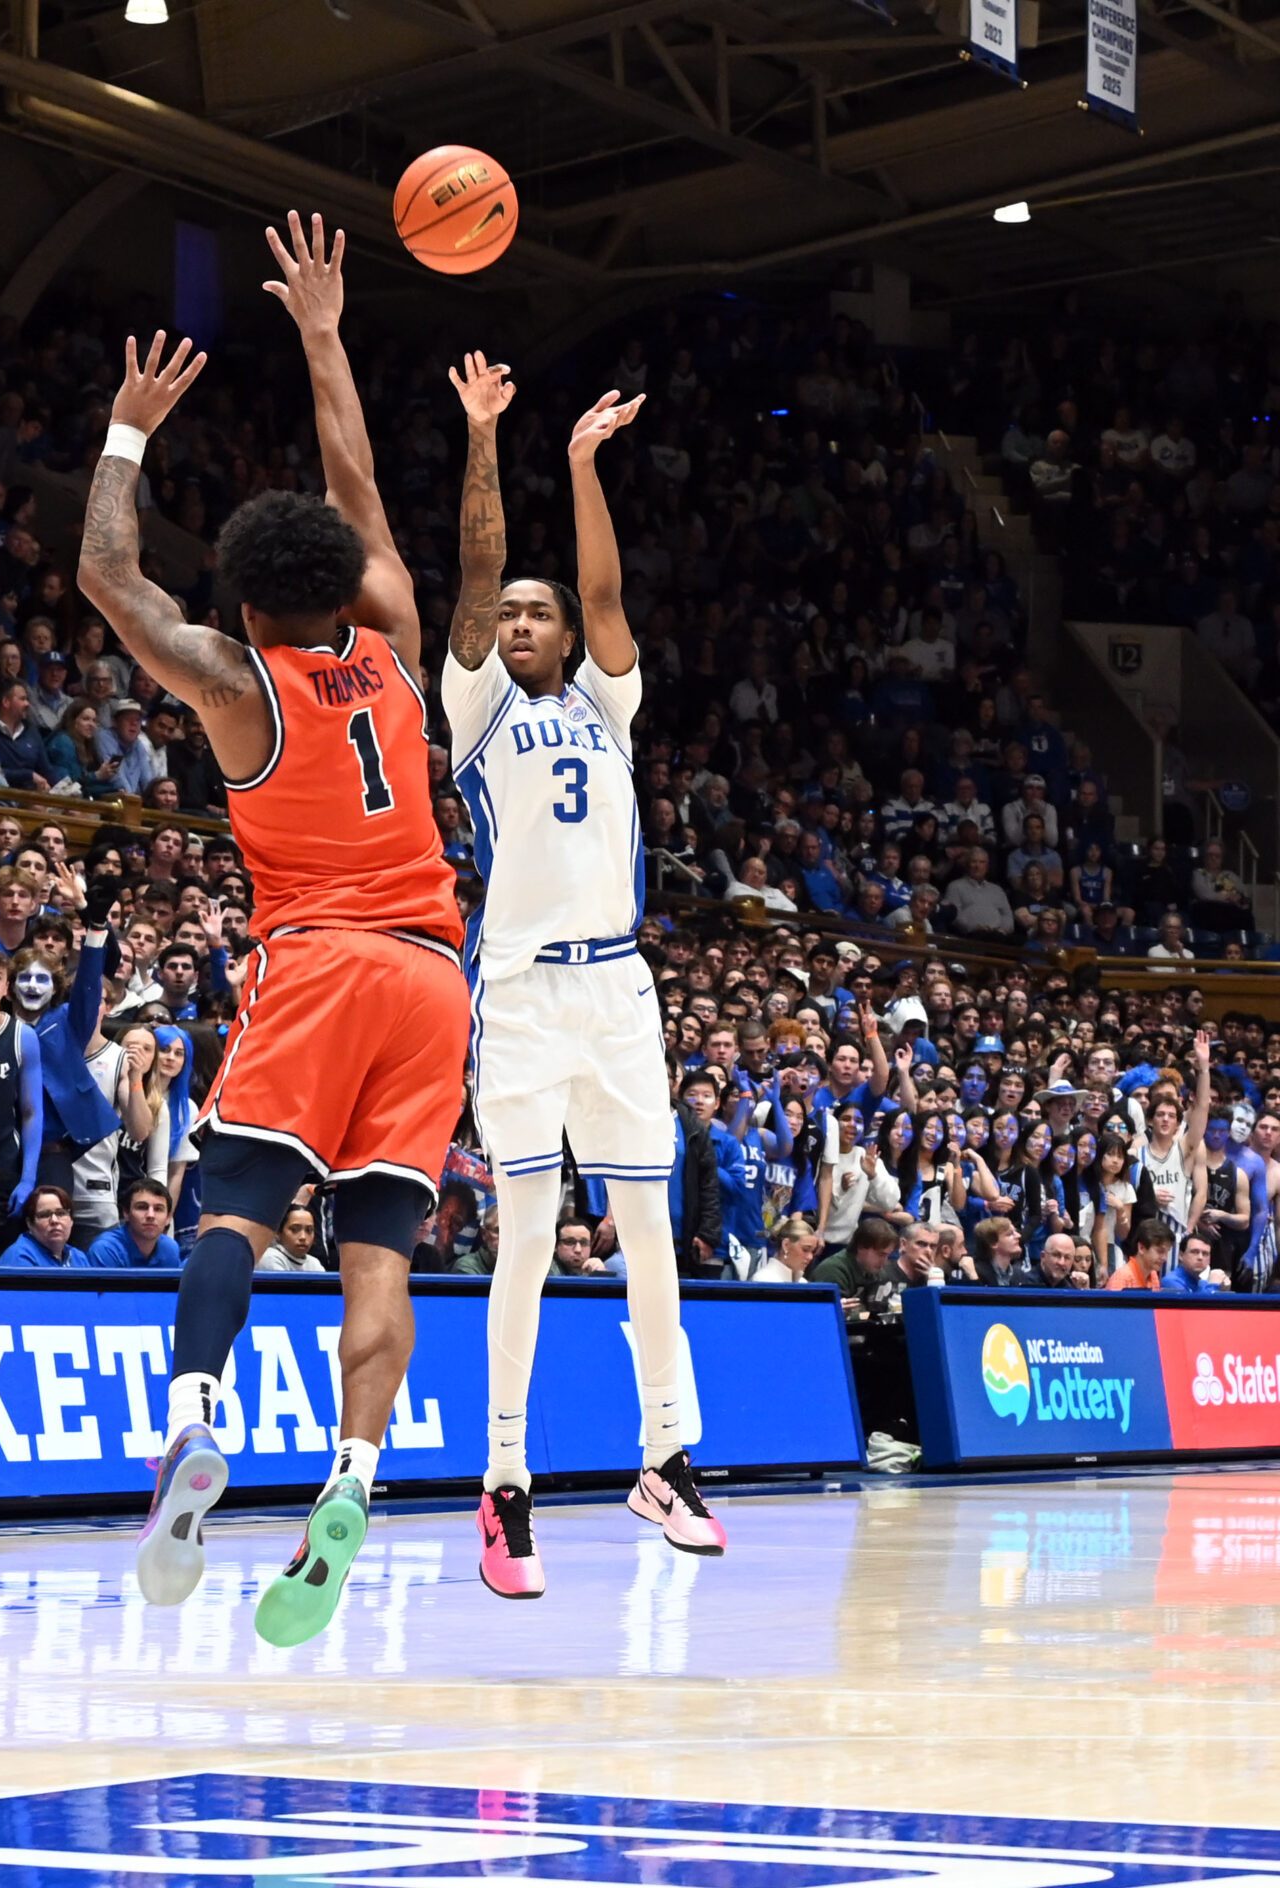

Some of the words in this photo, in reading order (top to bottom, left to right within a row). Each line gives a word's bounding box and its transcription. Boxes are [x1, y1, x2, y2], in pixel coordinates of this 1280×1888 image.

[1115, 645, 1138, 668] 12
[347, 706, 395, 816] 1
[510, 718, 608, 756] DUKE
[552, 757, 589, 823] 3
[1026, 1338, 1047, 1363] NC
[1048, 1340, 1104, 1364] Education
[1030, 1366, 1134, 1434] Lottery
[1224, 1352, 1277, 1405] State
